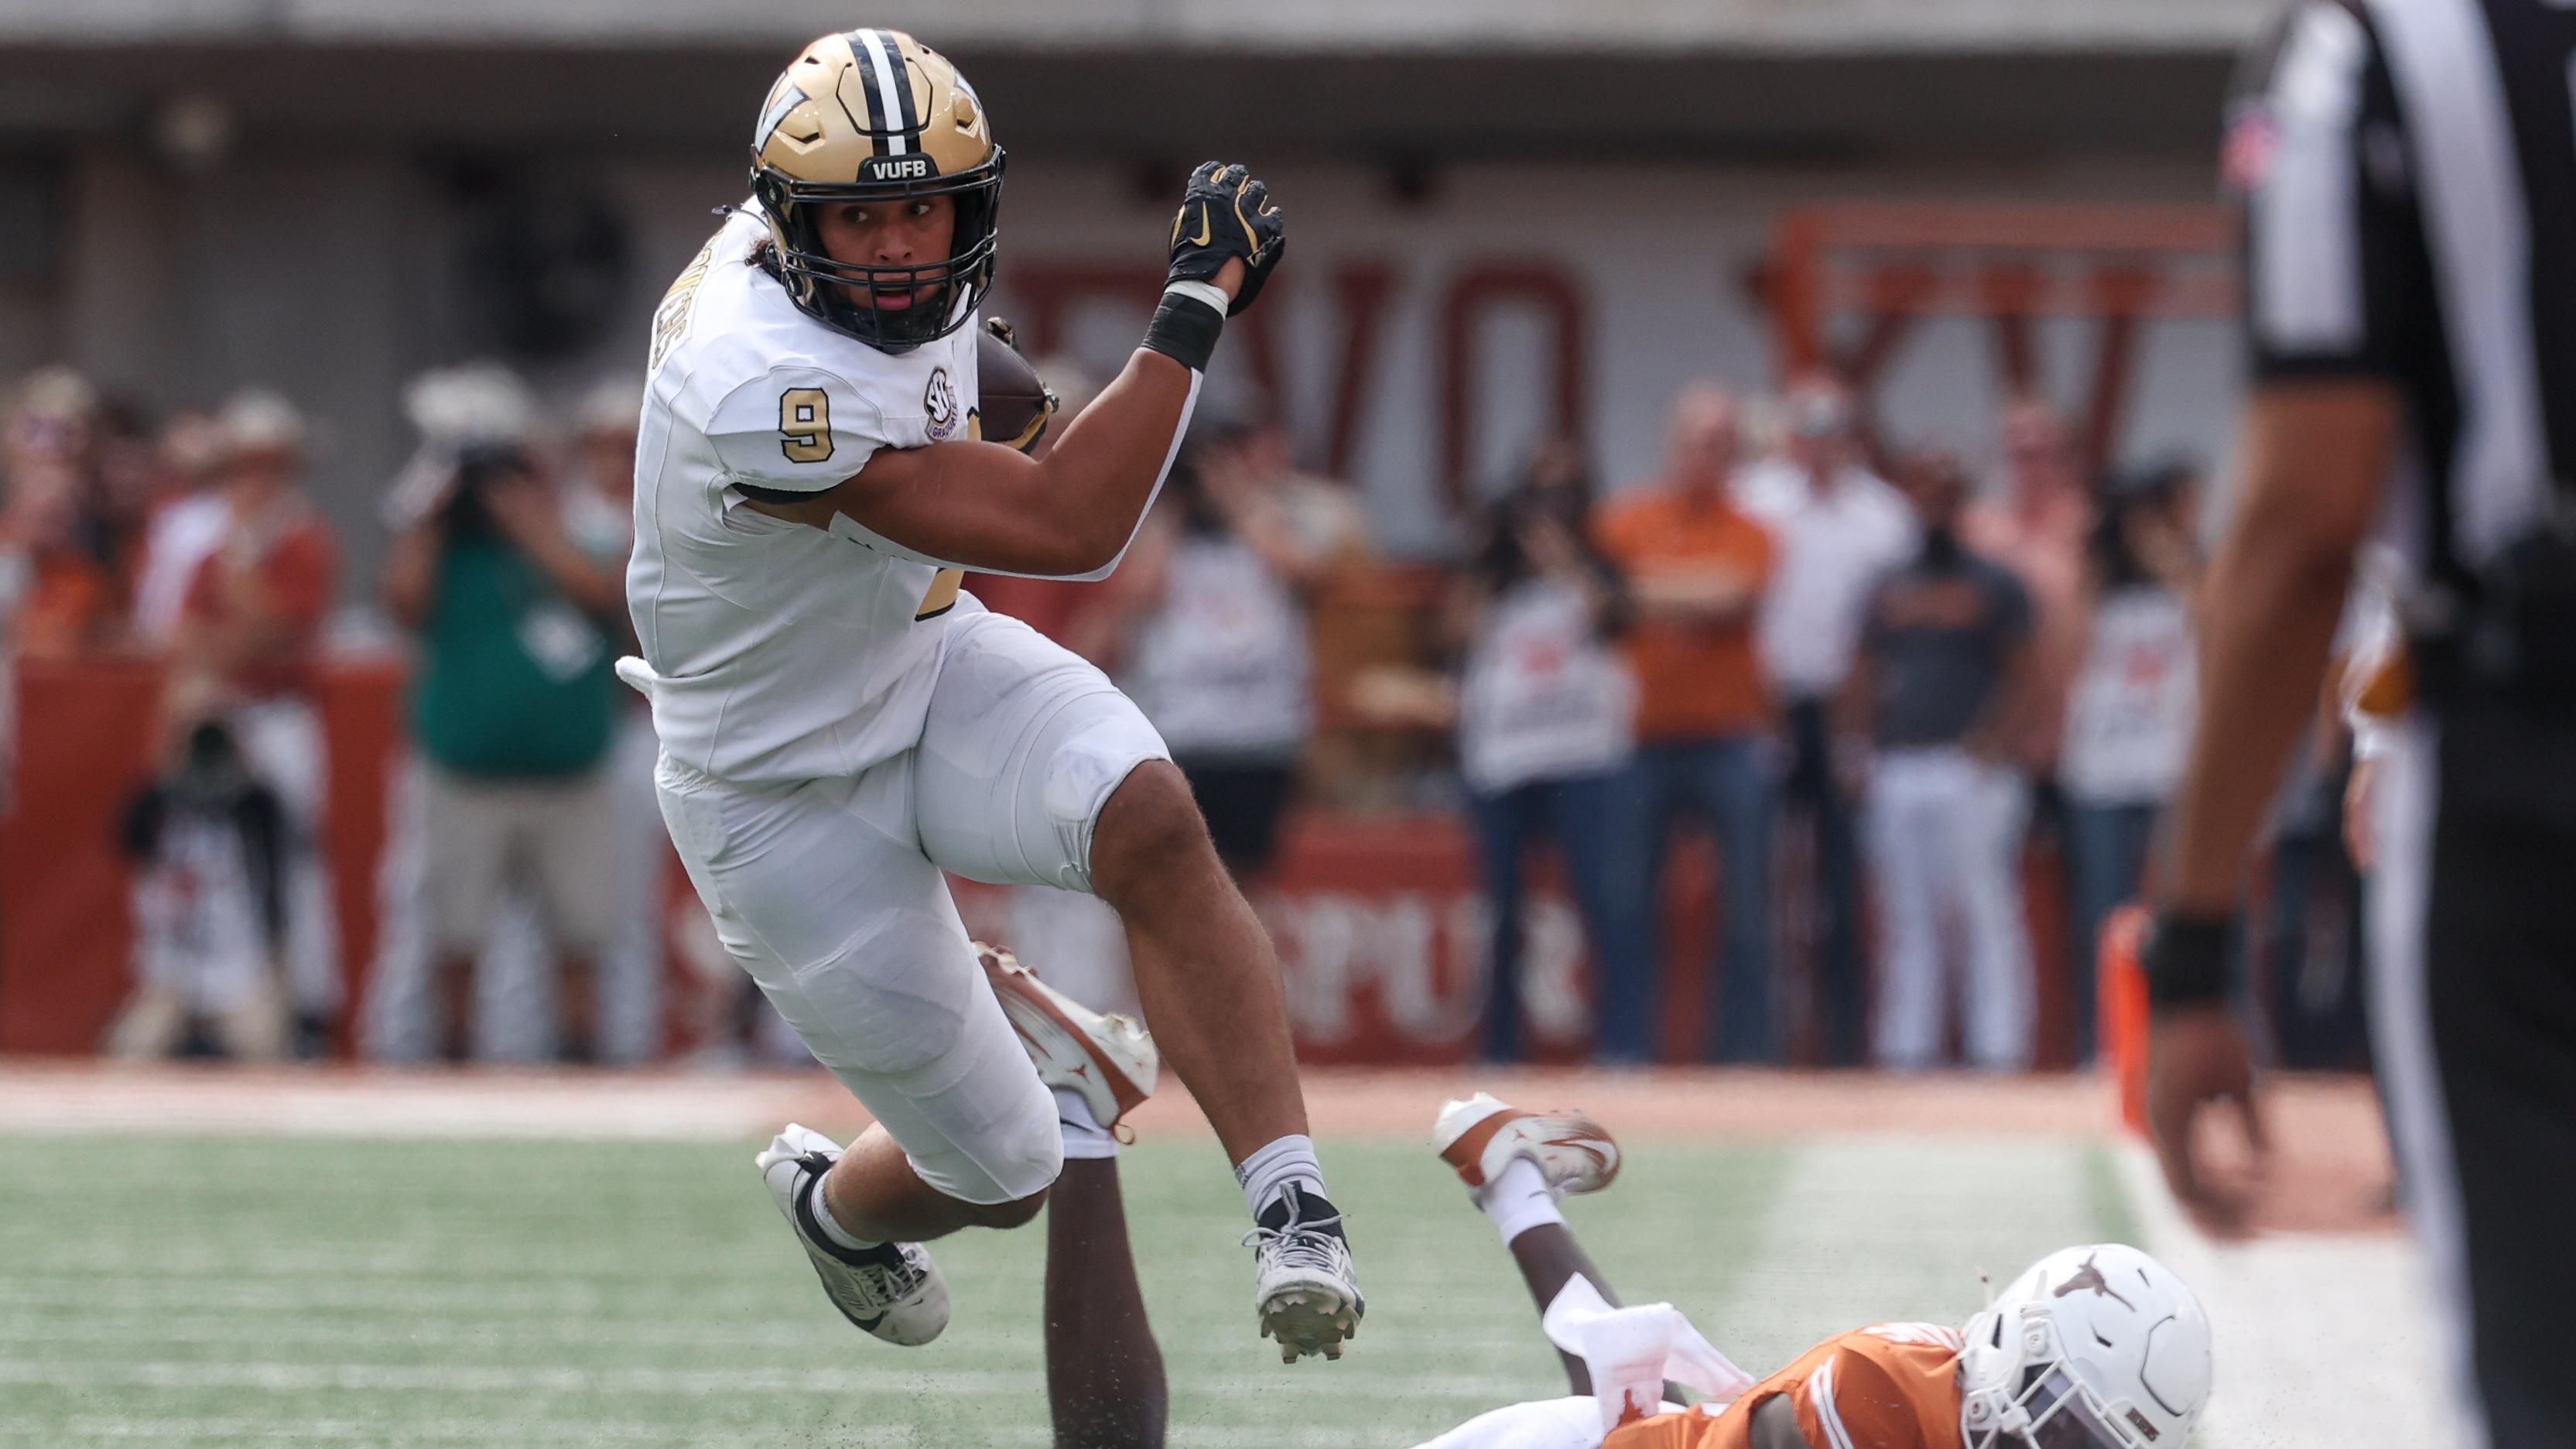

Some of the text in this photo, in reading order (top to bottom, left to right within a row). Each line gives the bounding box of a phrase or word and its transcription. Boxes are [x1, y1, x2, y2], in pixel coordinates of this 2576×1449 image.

[872, 159, 927, 180] VUFB
[926, 370, 951, 422] SEC
[778, 387, 836, 464] 9
